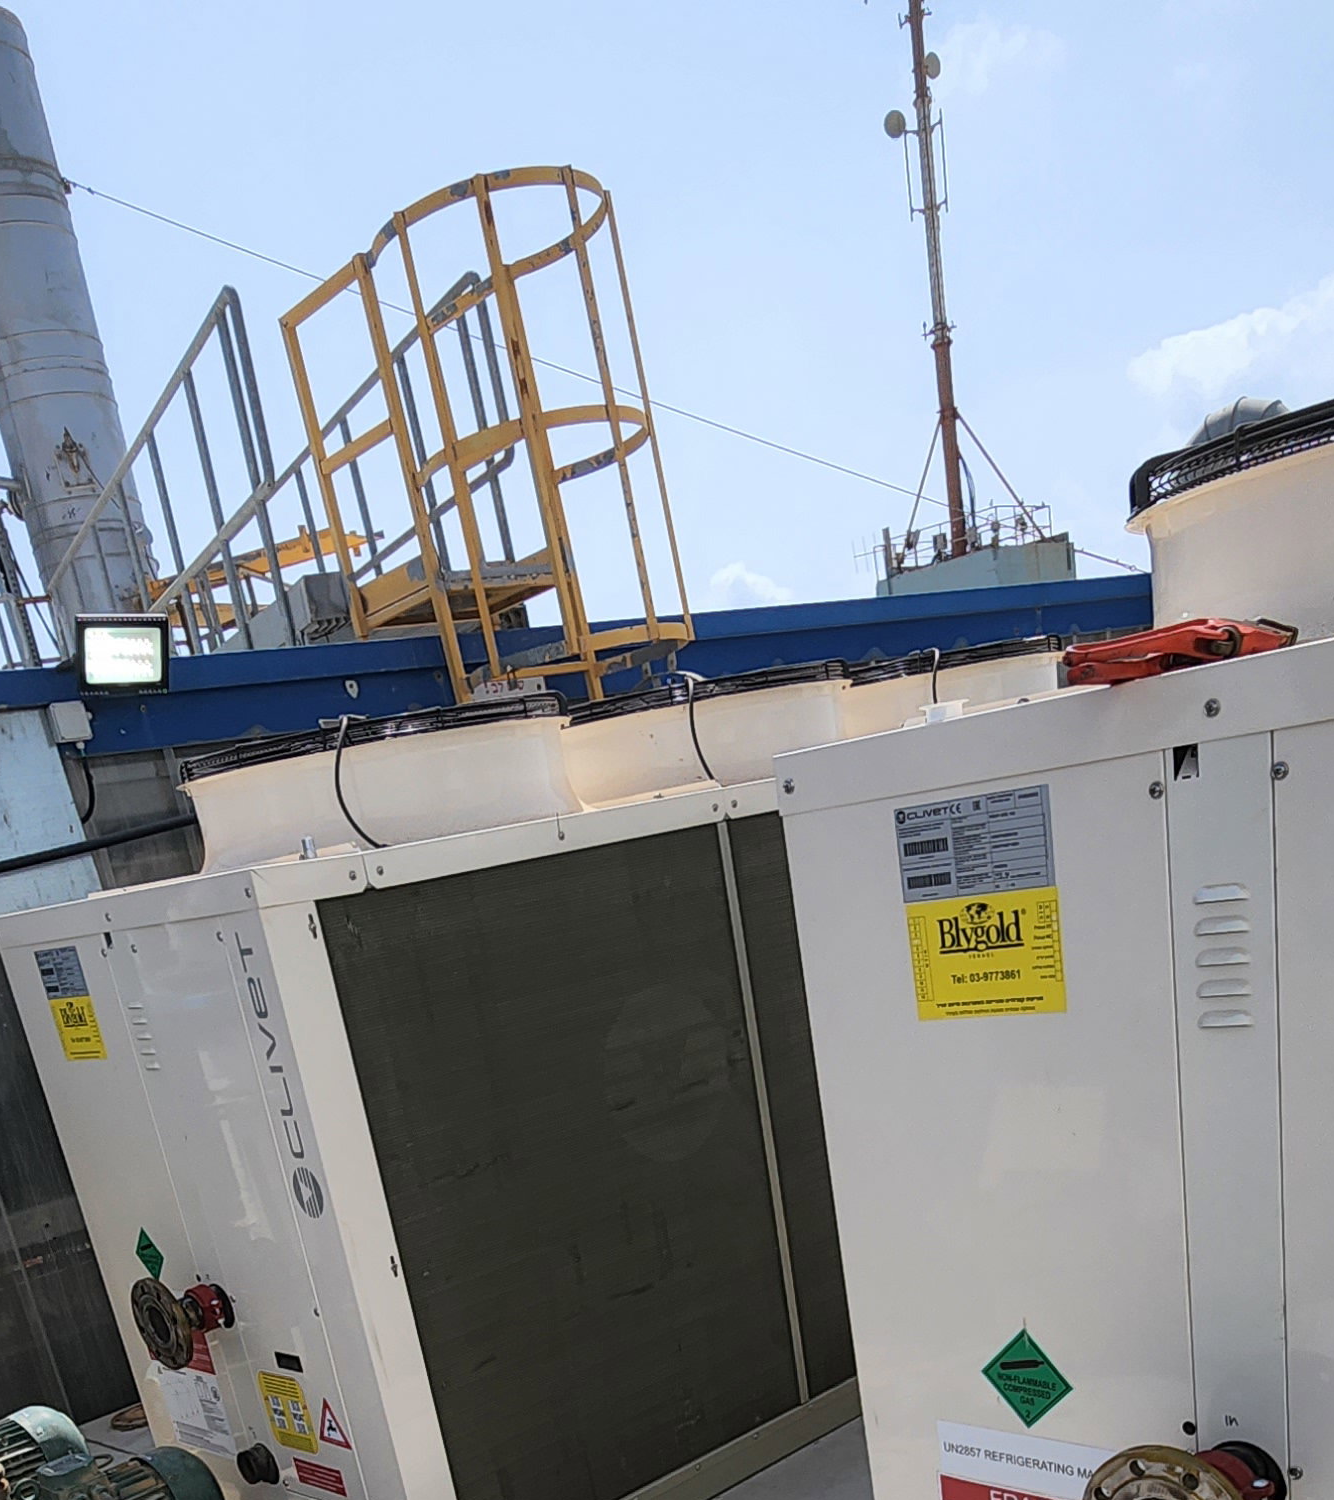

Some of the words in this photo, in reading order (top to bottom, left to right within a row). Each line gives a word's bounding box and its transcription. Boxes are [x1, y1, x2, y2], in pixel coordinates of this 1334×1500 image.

[937, 909, 1024, 952] Blygold
[951, 973, 968, 985] Tel:
[970, 969, 1021, 984] 03-9773861
[997, 1373, 1057, 1391] NON-FLAMMABLE
[1003, 1383, 1051, 1400] COMPRESSED
[1019, 1395, 1035, 1406] GAS
[1024, 1410, 1031, 1419] 2
[943, 1441, 981, 1459] UN2857
[984, 1449, 1074, 1476] REFRIGERATING
